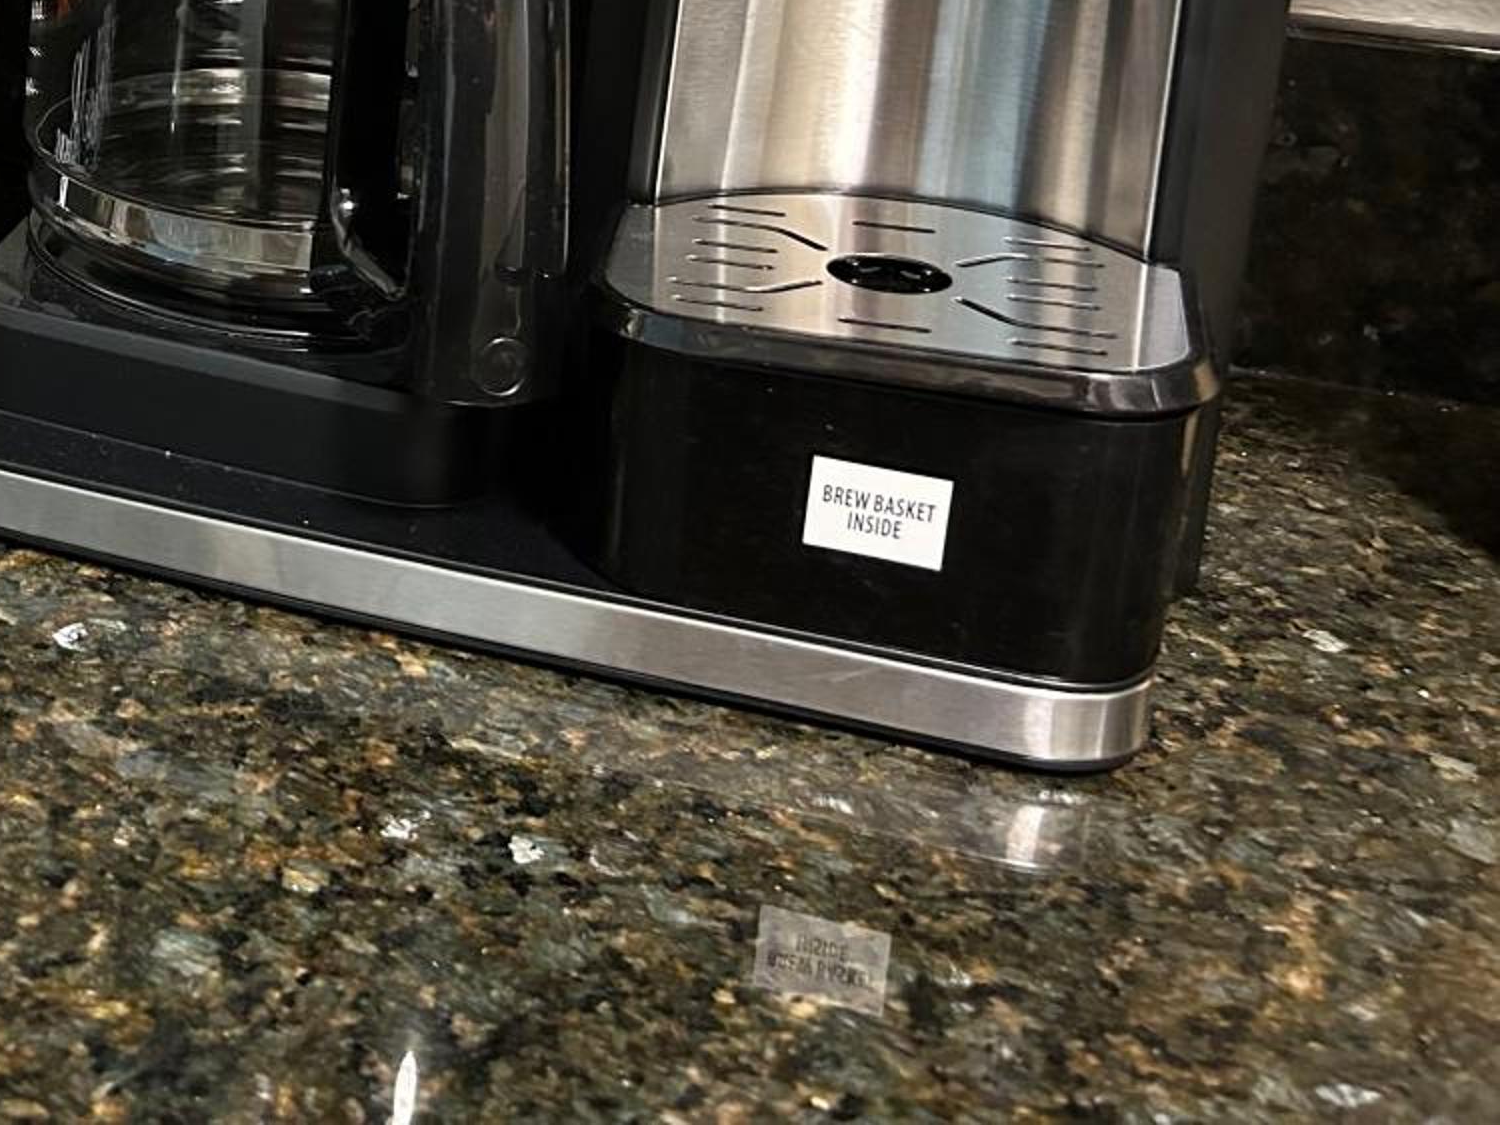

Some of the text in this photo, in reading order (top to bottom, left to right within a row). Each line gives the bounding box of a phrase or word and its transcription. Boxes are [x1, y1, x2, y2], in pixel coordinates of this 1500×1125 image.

[822, 484, 937, 523] BREW BASKET
[847, 510, 903, 540] INSIDE
